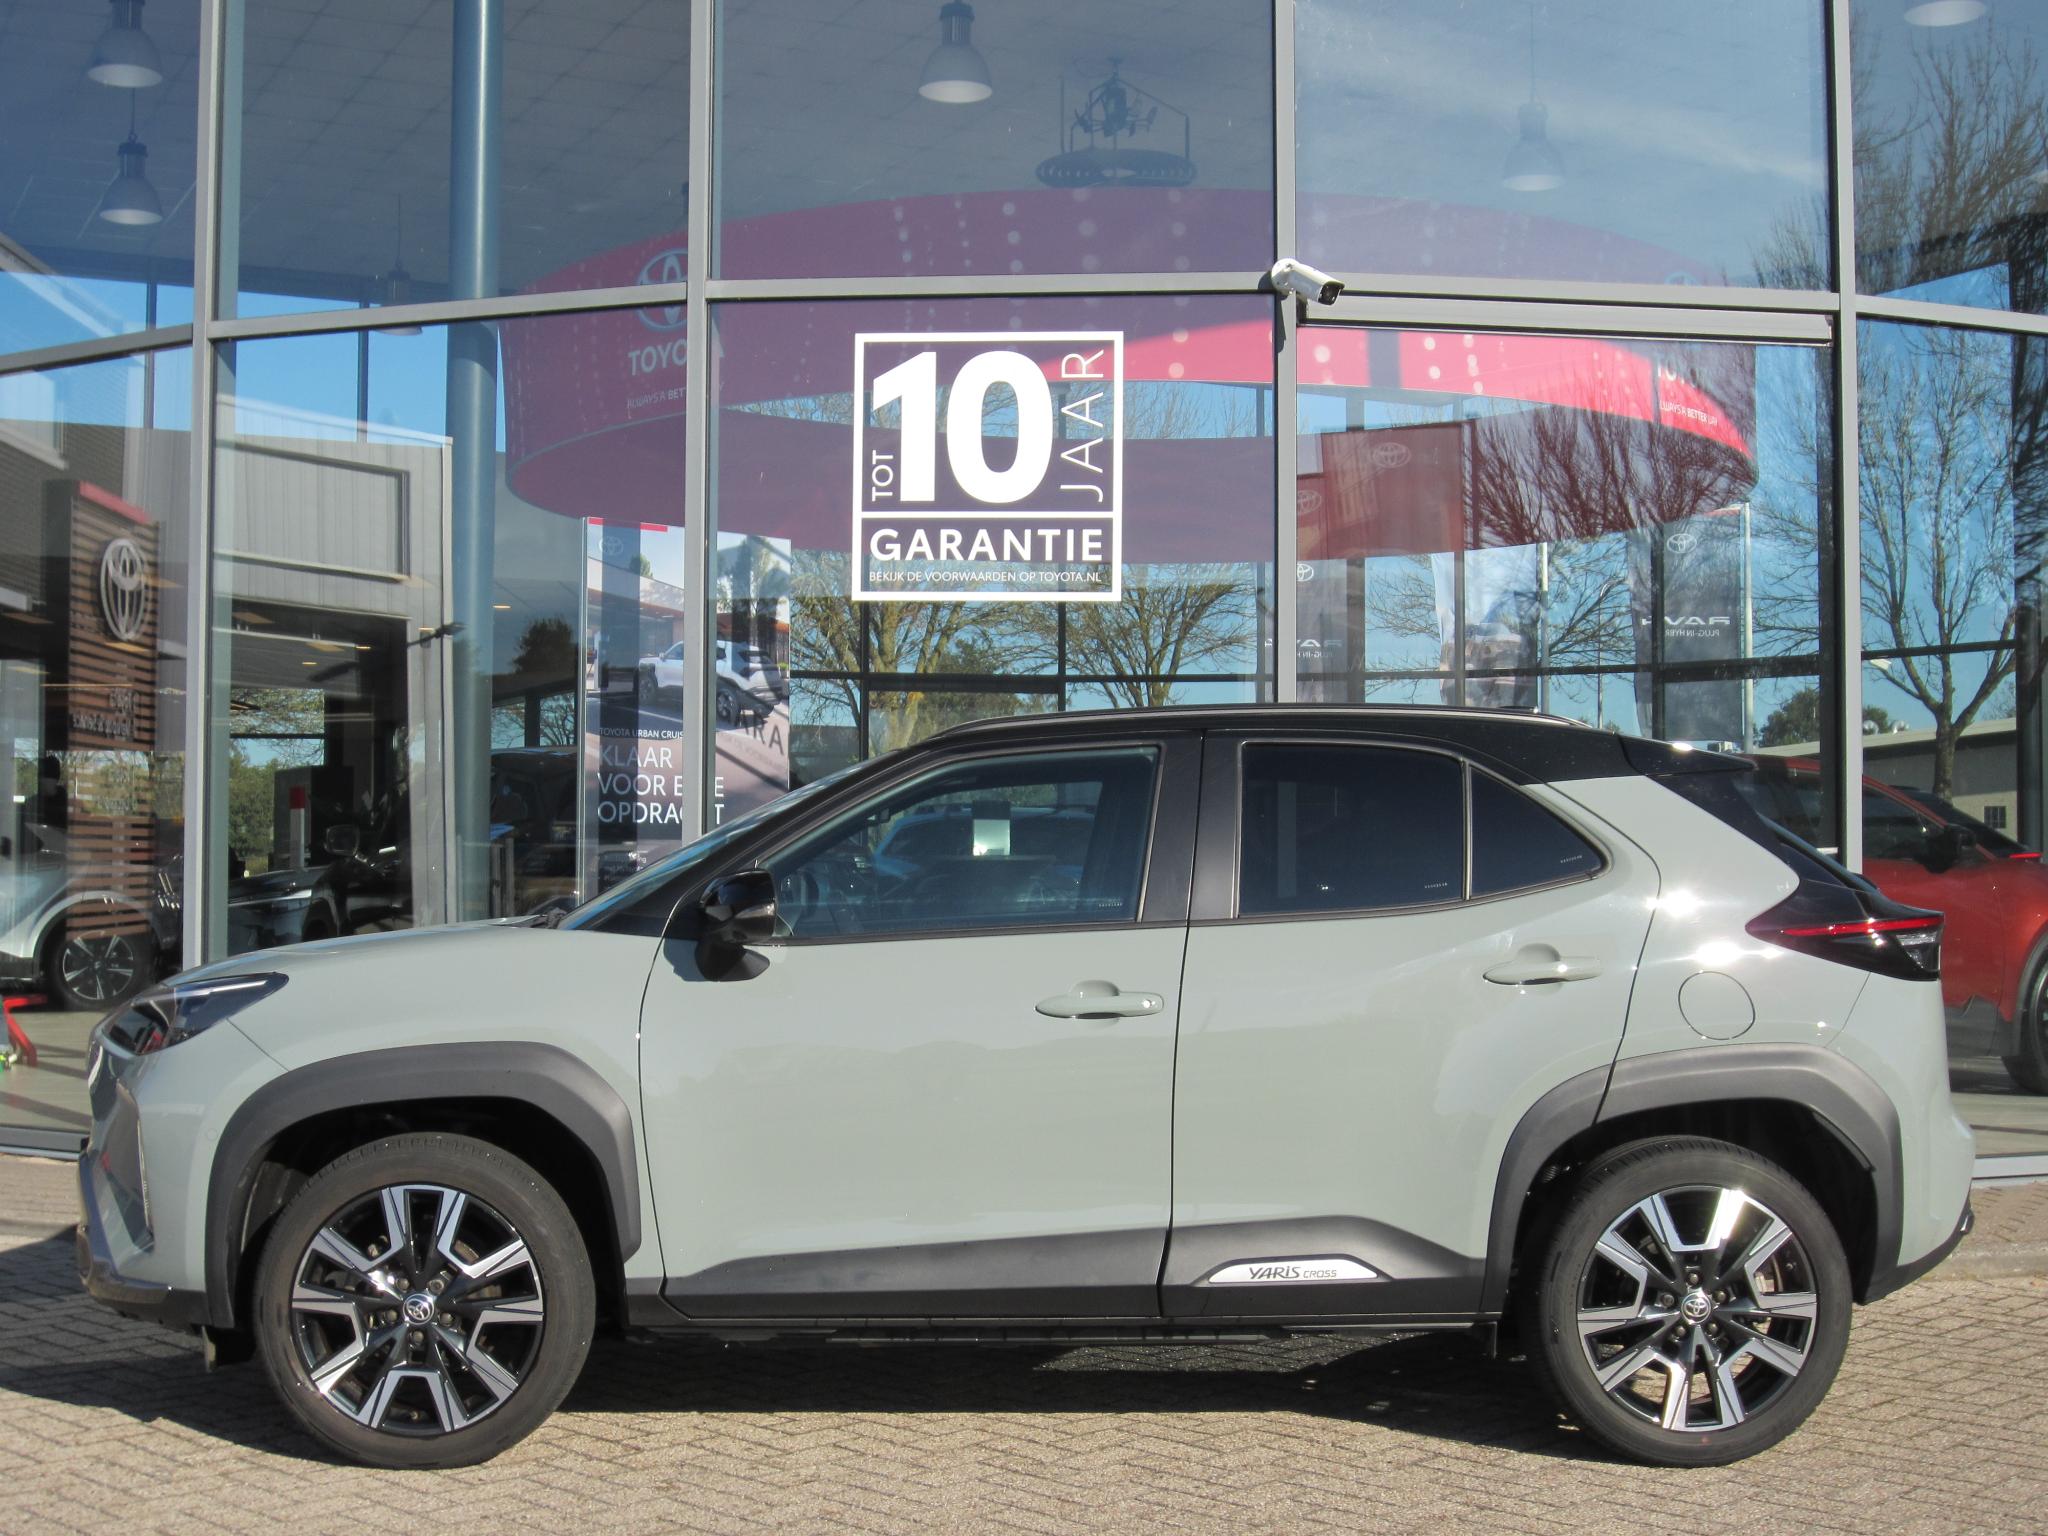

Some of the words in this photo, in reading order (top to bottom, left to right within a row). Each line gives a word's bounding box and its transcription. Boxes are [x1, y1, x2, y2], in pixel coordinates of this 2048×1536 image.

[628, 338, 724, 376] TOYO
[873, 351, 1053, 503] 10
[1061, 350, 1104, 502] JAAR
[872, 450, 894, 501] TOT
[870, 528, 1102, 561] GARANTIE
[869, 571, 904, 582] BEKIJK
[907, 571, 921, 582] DE
[924, 571, 1016, 582] VOORWAARDEN
[1020, 571, 1035, 582] OP
[1038, 571, 1102, 582] TOYOTA.NL
[632, 729, 660, 738] URBAN
[600, 744, 673, 769] KLAAR
[597, 772, 667, 797] VOOR
[597, 801, 725, 825] OPDRAT
[1303, 1269, 1337, 1279] CROSS
